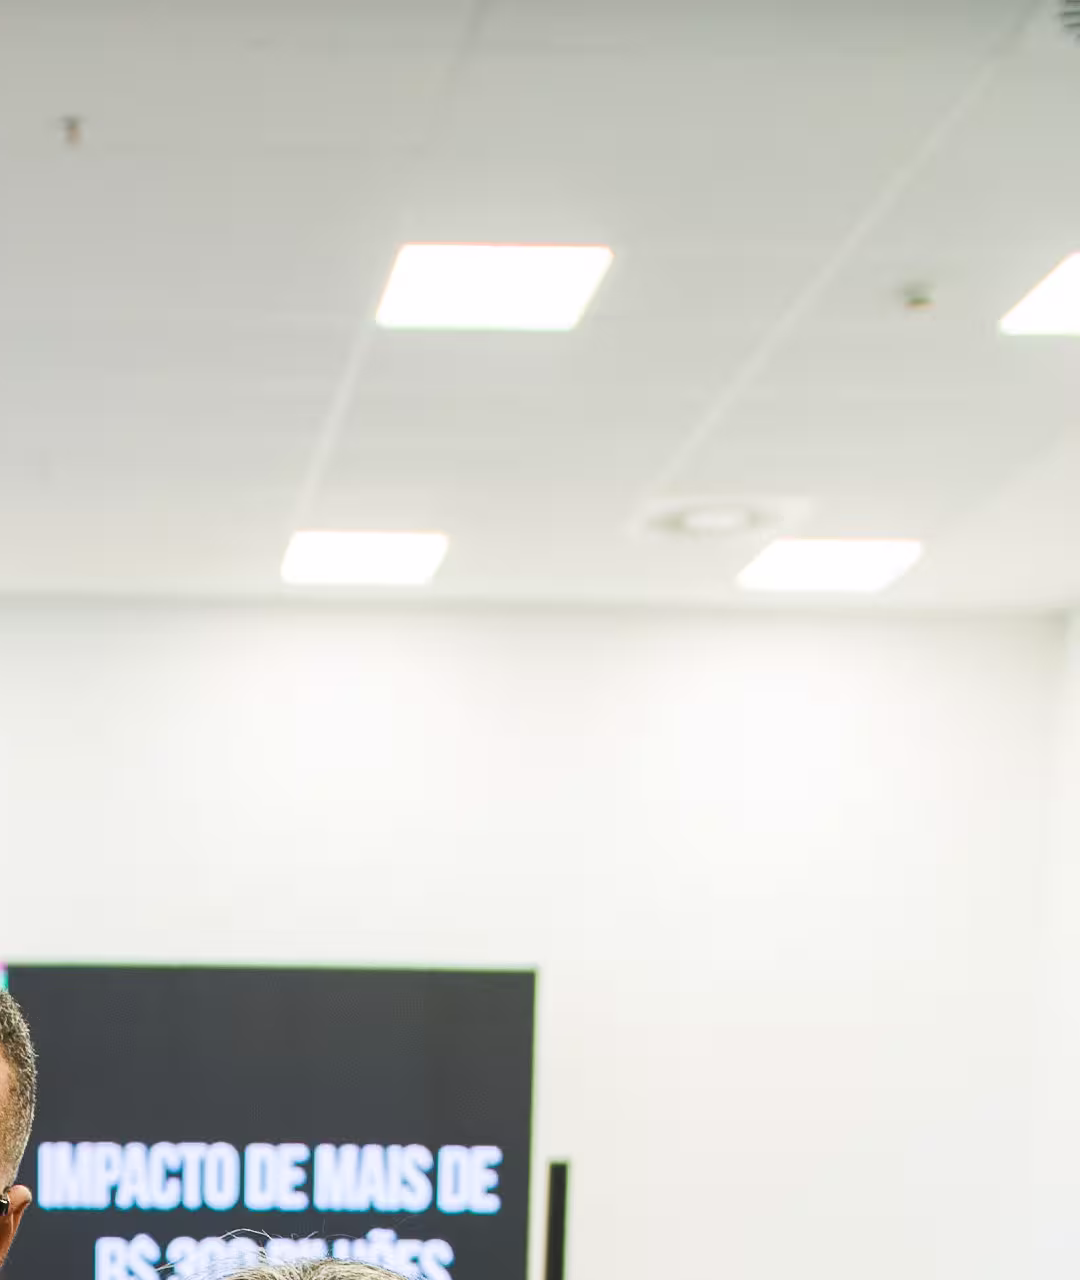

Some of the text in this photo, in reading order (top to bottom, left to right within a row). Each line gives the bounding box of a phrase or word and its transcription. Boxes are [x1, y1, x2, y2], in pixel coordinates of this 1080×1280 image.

[37, 1141, 504, 1215] IMPACTO DE MAIS DE
